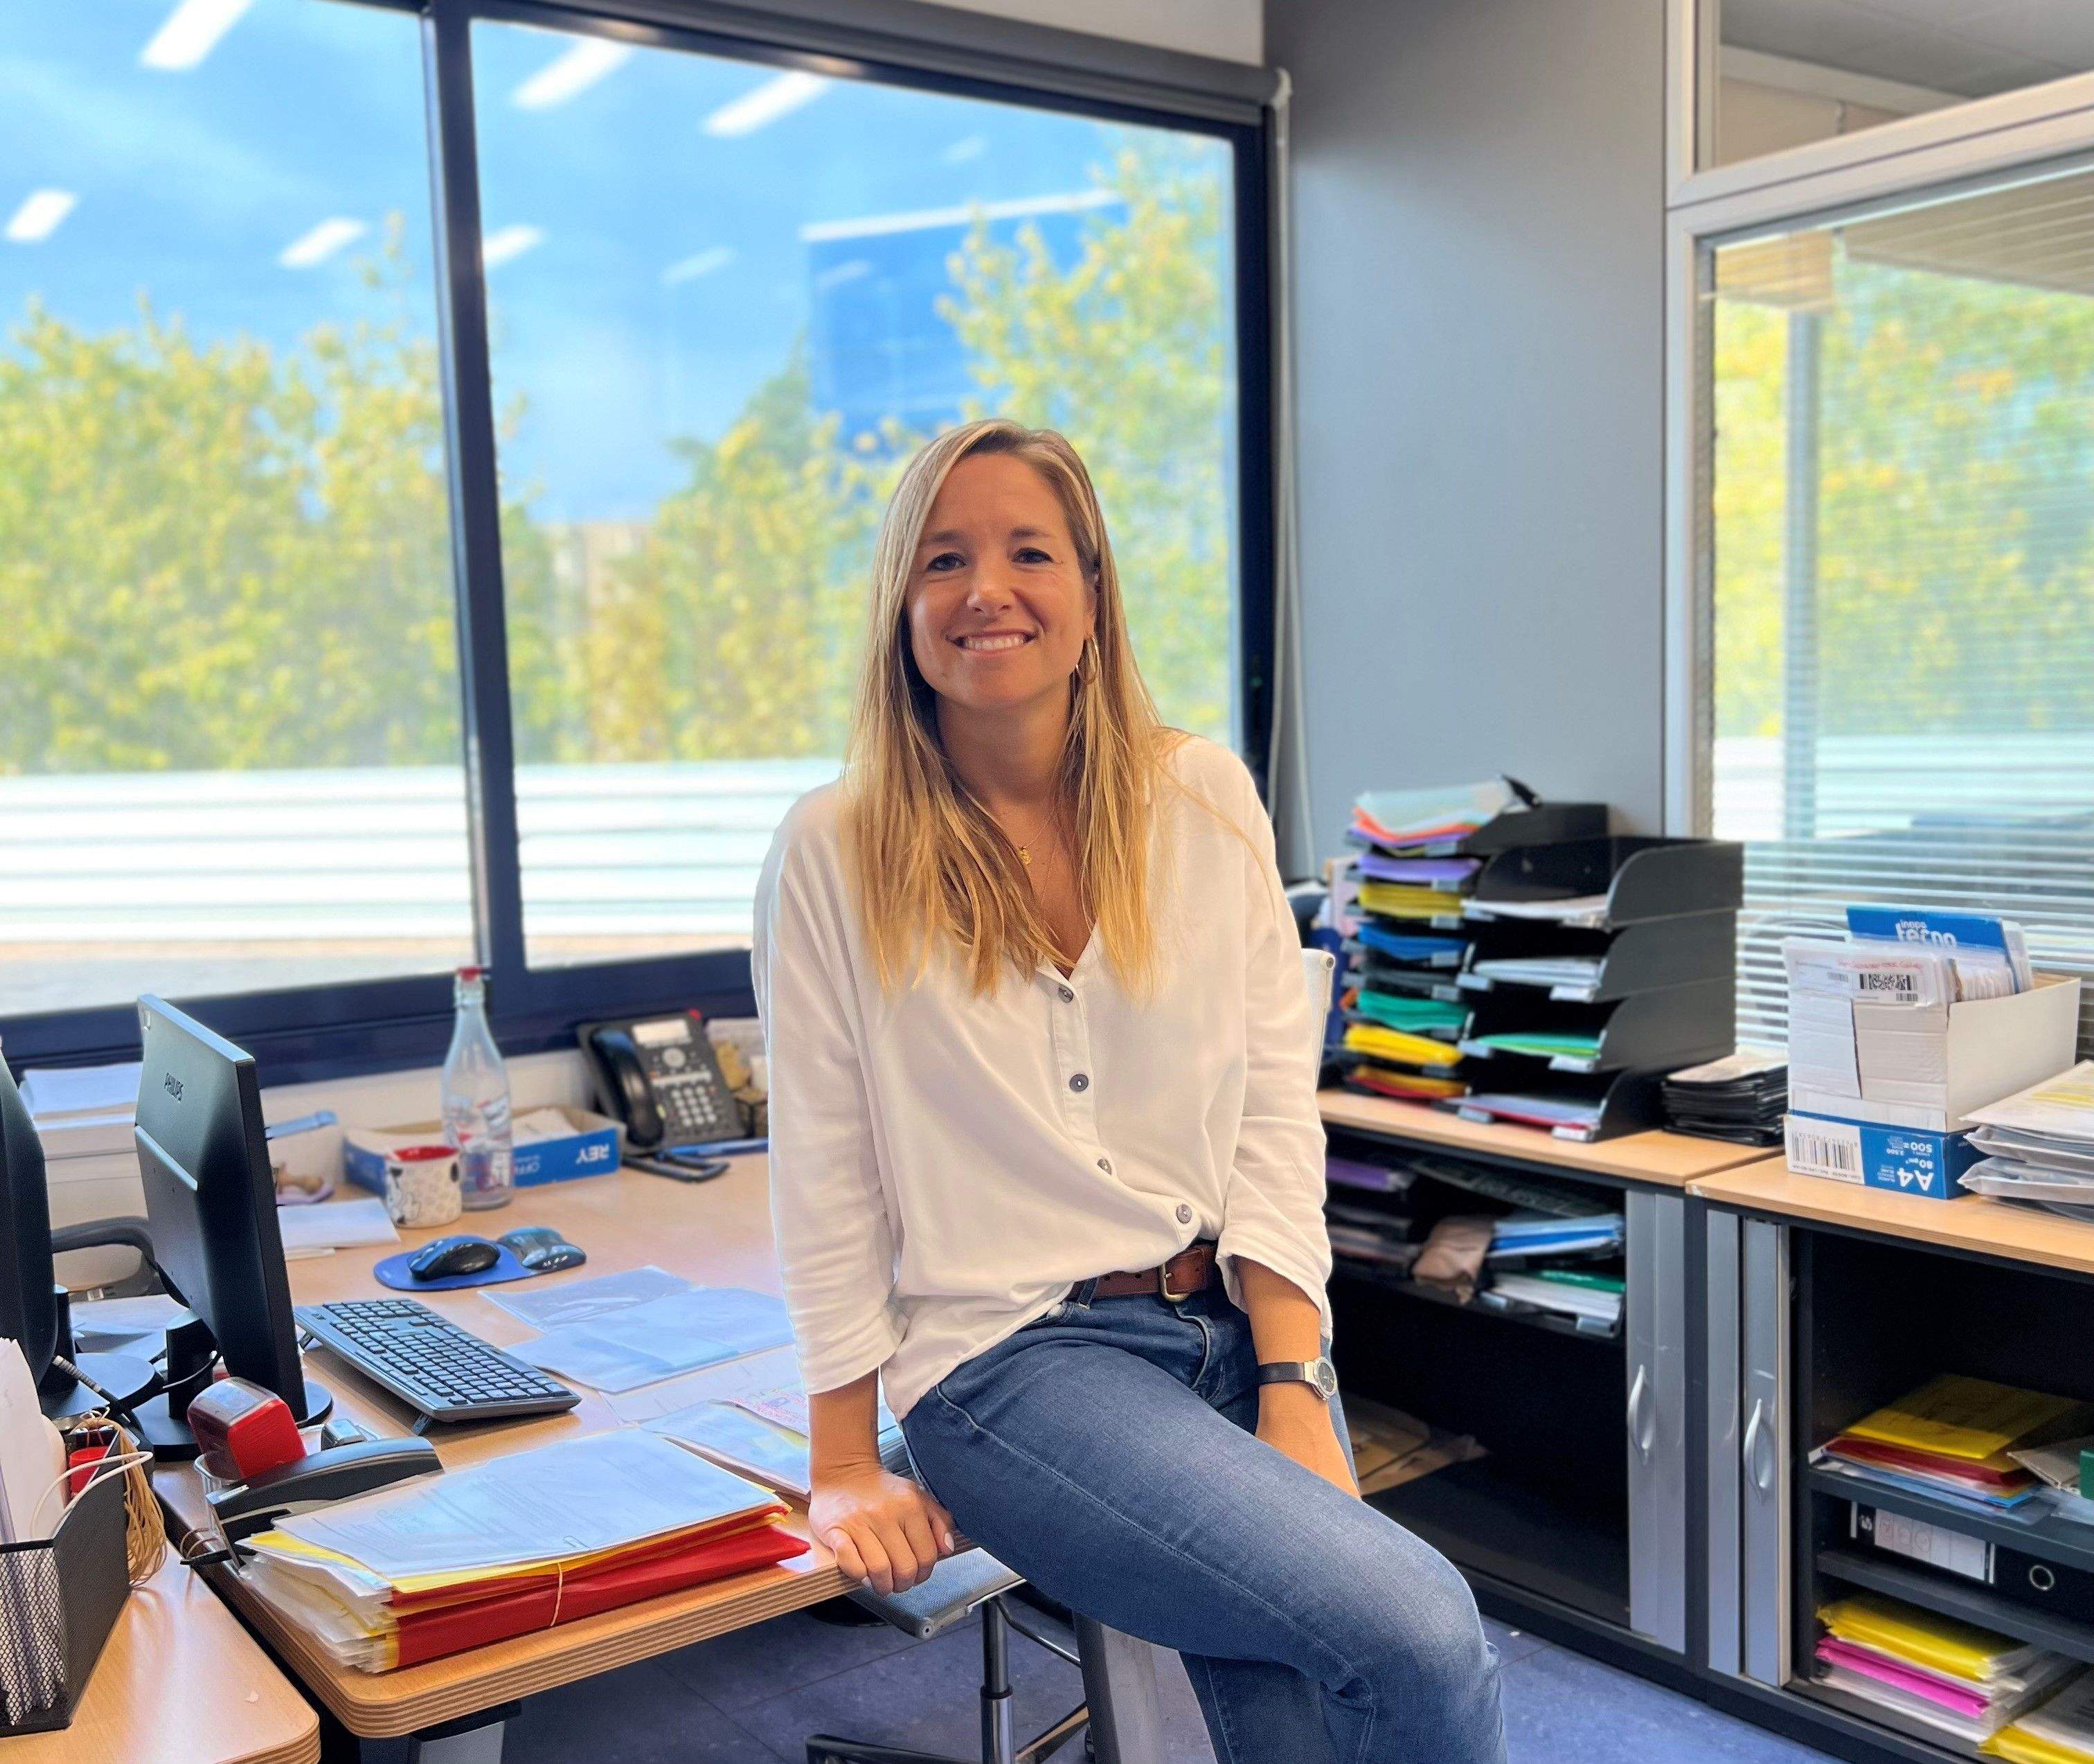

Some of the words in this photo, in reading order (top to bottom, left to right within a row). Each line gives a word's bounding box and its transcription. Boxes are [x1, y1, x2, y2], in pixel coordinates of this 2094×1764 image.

[164, 1072, 184, 1101] PHILIPS
[575, 1143, 610, 1164] REY
[1910, 1142, 1933, 1153] 500
[1897, 1167, 1934, 1191] A4
